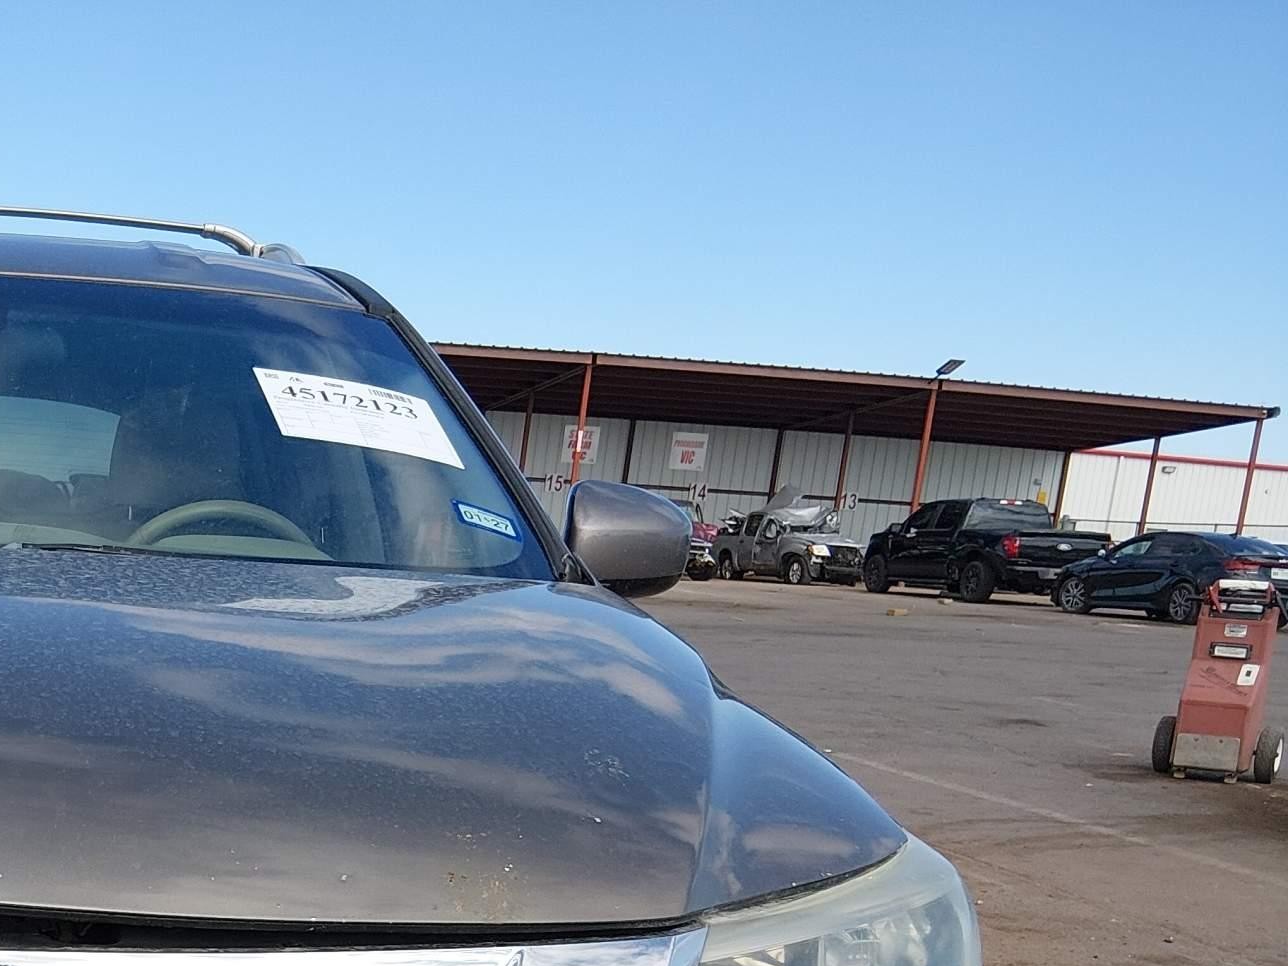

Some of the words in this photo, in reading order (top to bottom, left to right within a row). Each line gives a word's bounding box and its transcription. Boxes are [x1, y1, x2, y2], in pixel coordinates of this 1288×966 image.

[281, 386, 418, 420] 45172123
[679, 450, 696, 465] VIC
[546, 475, 563, 491] 15
[691, 484, 707, 500] 14
[841, 493, 857, 510] 13
